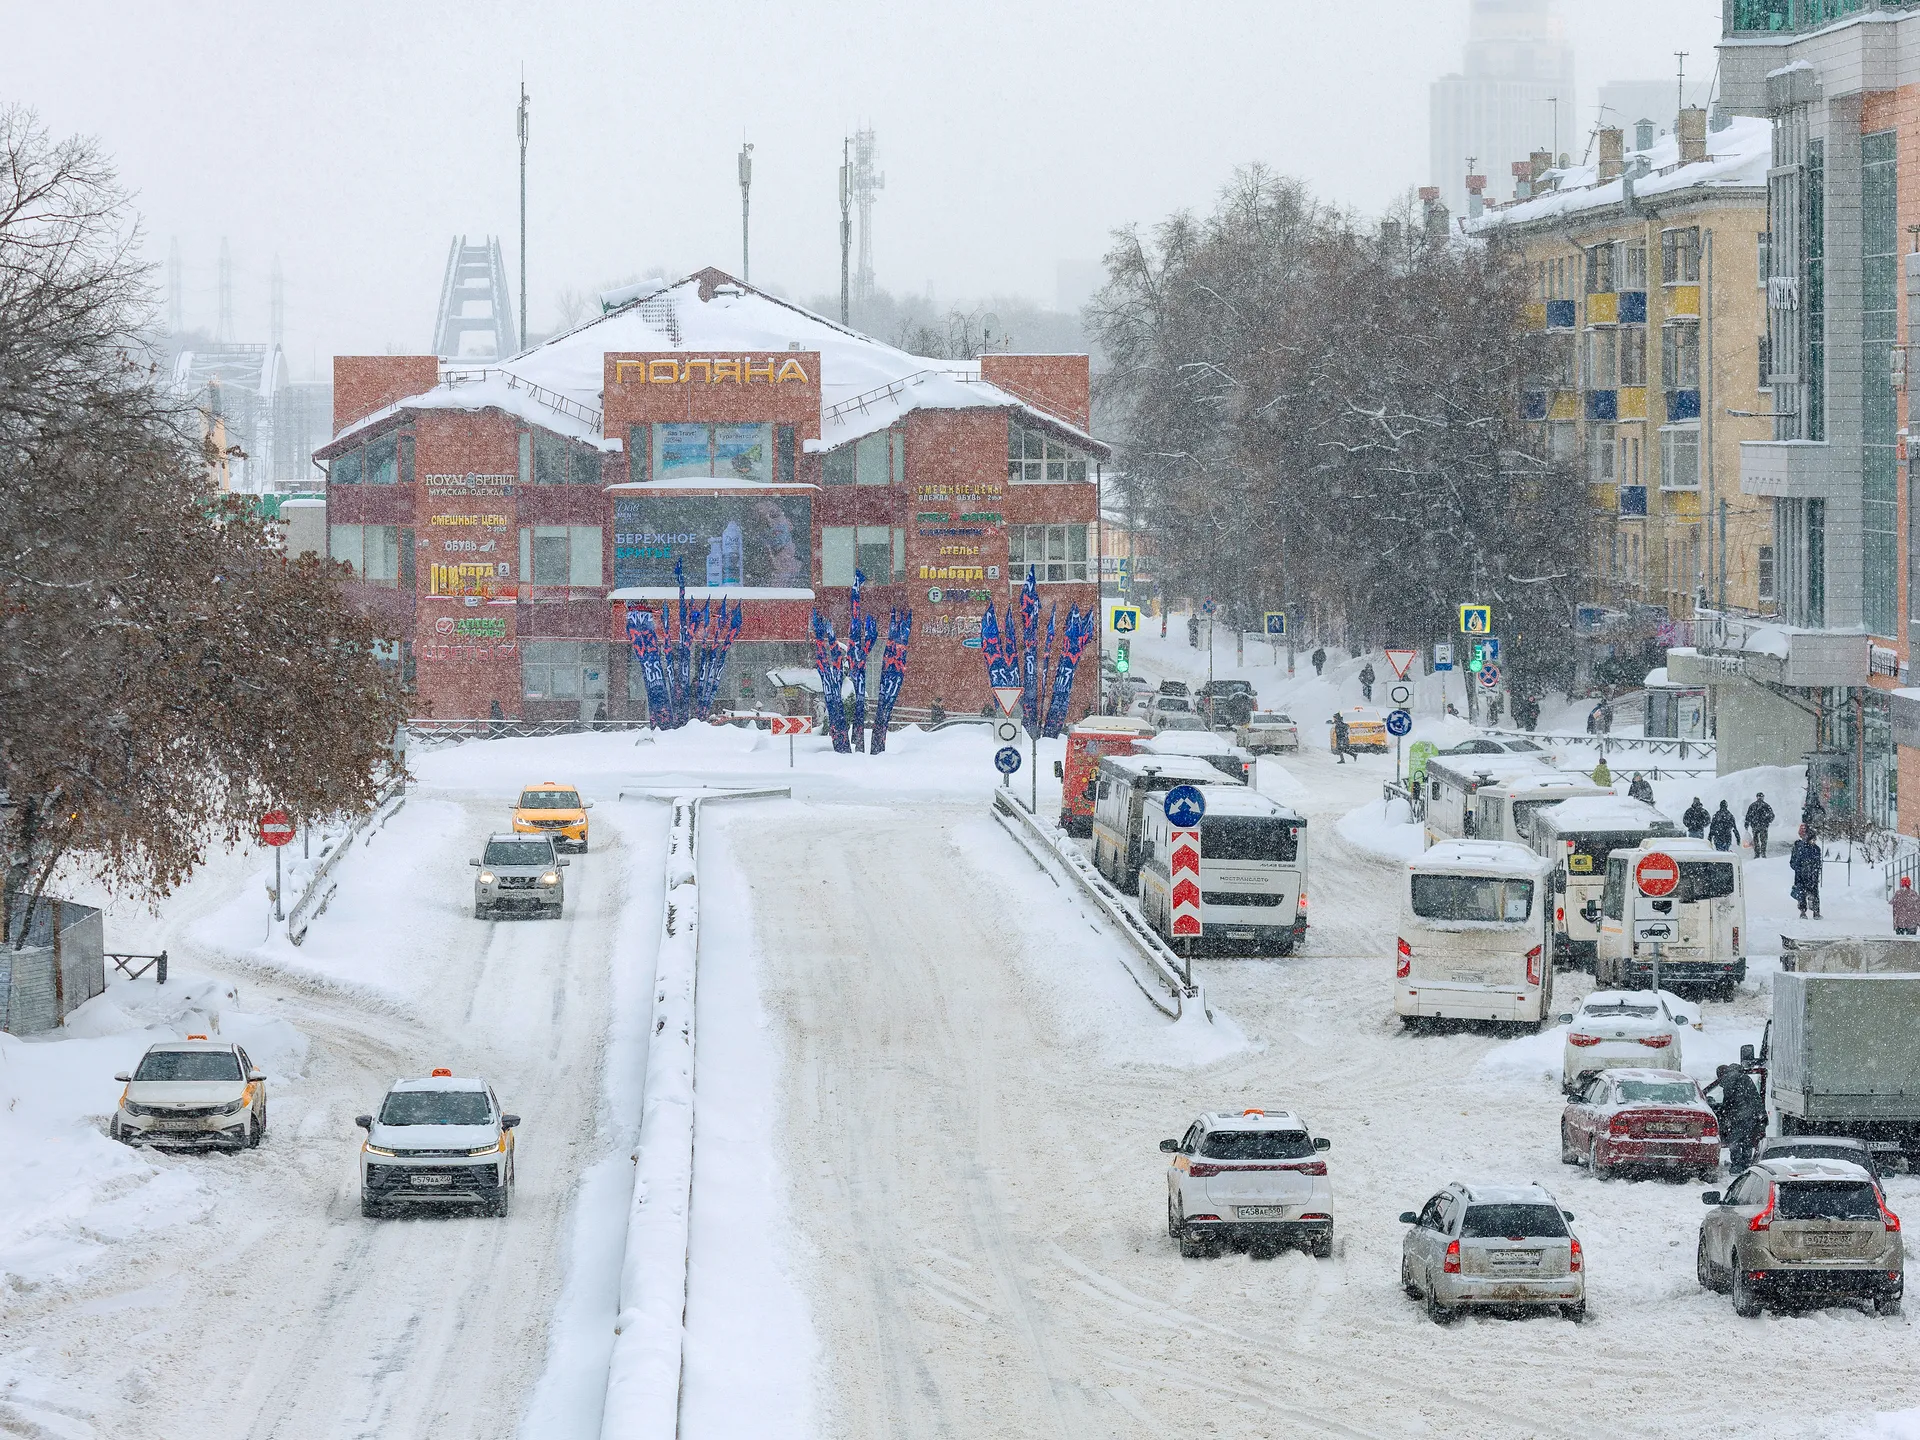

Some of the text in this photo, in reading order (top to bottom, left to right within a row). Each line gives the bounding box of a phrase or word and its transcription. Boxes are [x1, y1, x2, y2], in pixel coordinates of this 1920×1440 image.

[616, 358, 809, 384] ПОЛЯНА
[425, 474, 515, 486] ROYAL SPIRIT
[428, 488, 467, 496] МУЖСКАЯ
[470, 488, 504, 496] ОДЕЖДА
[918, 485, 969, 495] СМЕШНЫЕ
[431, 515, 507, 527] СМЕШНЫЕ ЦЕНЫ
[617, 533, 697, 544] БЕРЕЖНОЕ
[444, 540, 477, 552] ОБУВЬ
[616, 544, 672, 559] БРИТЬЁ
[940, 546, 979, 555] АТЕЛЬЕ
[920, 566, 984, 582] Ломбард
[457, 617, 505, 629] АПТЕКА
